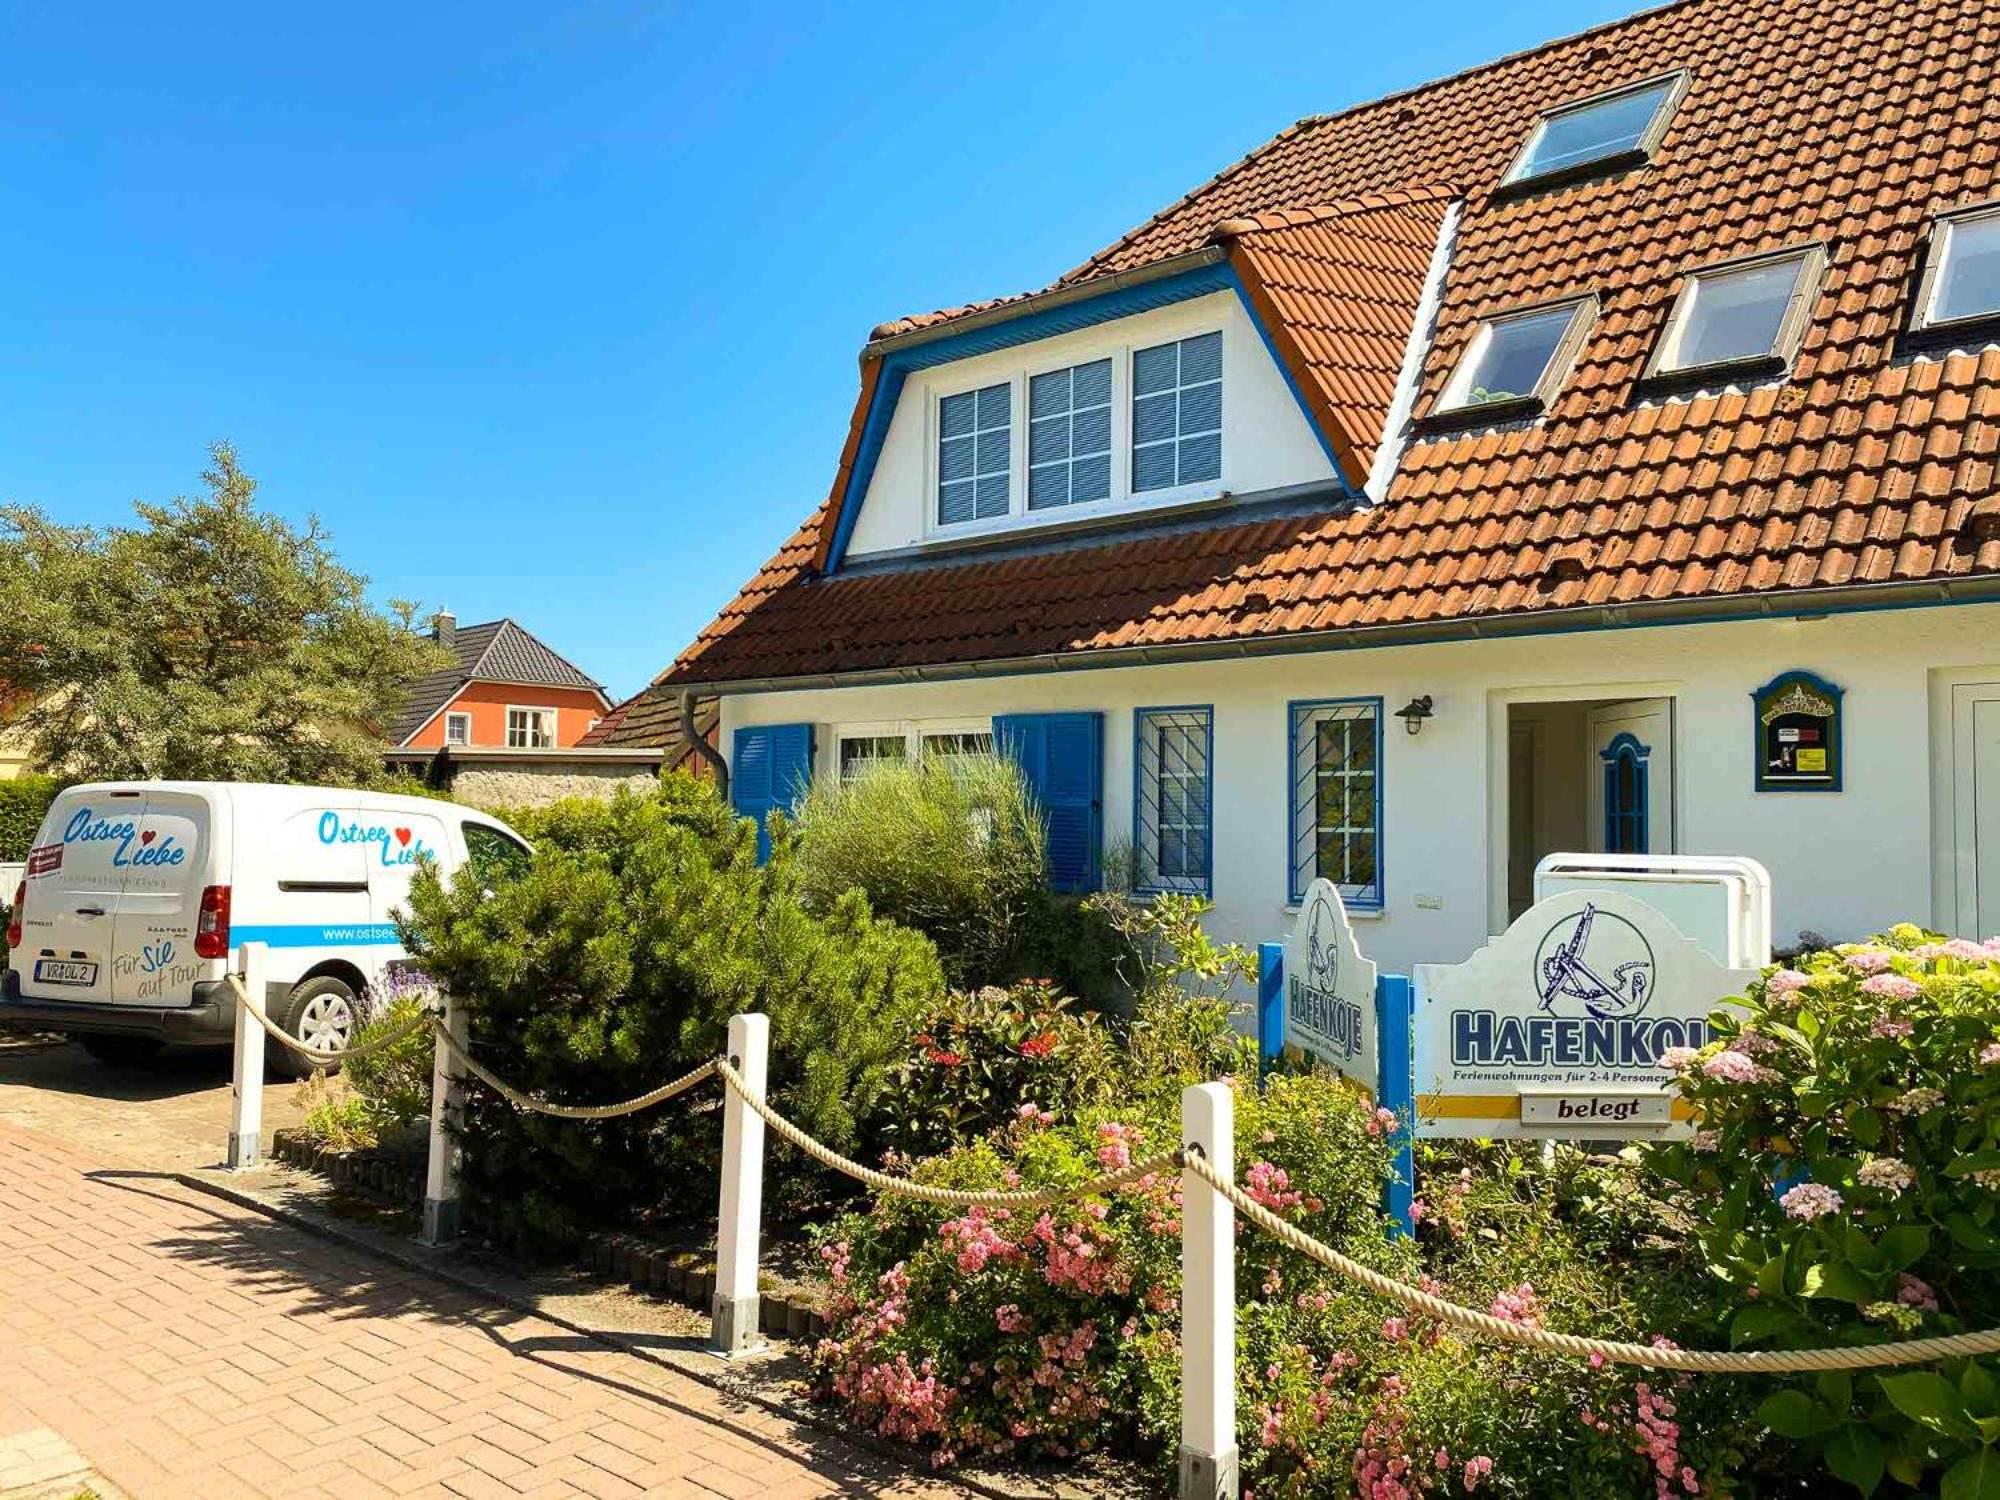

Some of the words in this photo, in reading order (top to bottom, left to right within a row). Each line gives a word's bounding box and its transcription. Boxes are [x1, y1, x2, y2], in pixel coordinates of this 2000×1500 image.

[64, 808, 134, 843] Ostsee
[318, 811, 386, 844] Ostsee
[113, 831, 184, 866] Liebe
[322, 927, 397, 940] www.ostsee
[80, 966, 88, 980] 2
[113, 954, 141, 979] Für
[141, 939, 176, 972] Sie
[138, 969, 165, 998] auf
[169, 963, 206, 988] Tour
[1289, 973, 1362, 1061] HAFENKOJE
[1451, 1010, 1720, 1069] HAFENKO
[1452, 1070, 1563, 1083] Ferienwohnungen
[1565, 1071, 1585, 1083] für
[1589, 1071, 1610, 1081] 2-4
[1612, 1072, 1668, 1083] Personen
[1558, 1099, 1640, 1121] belegt
